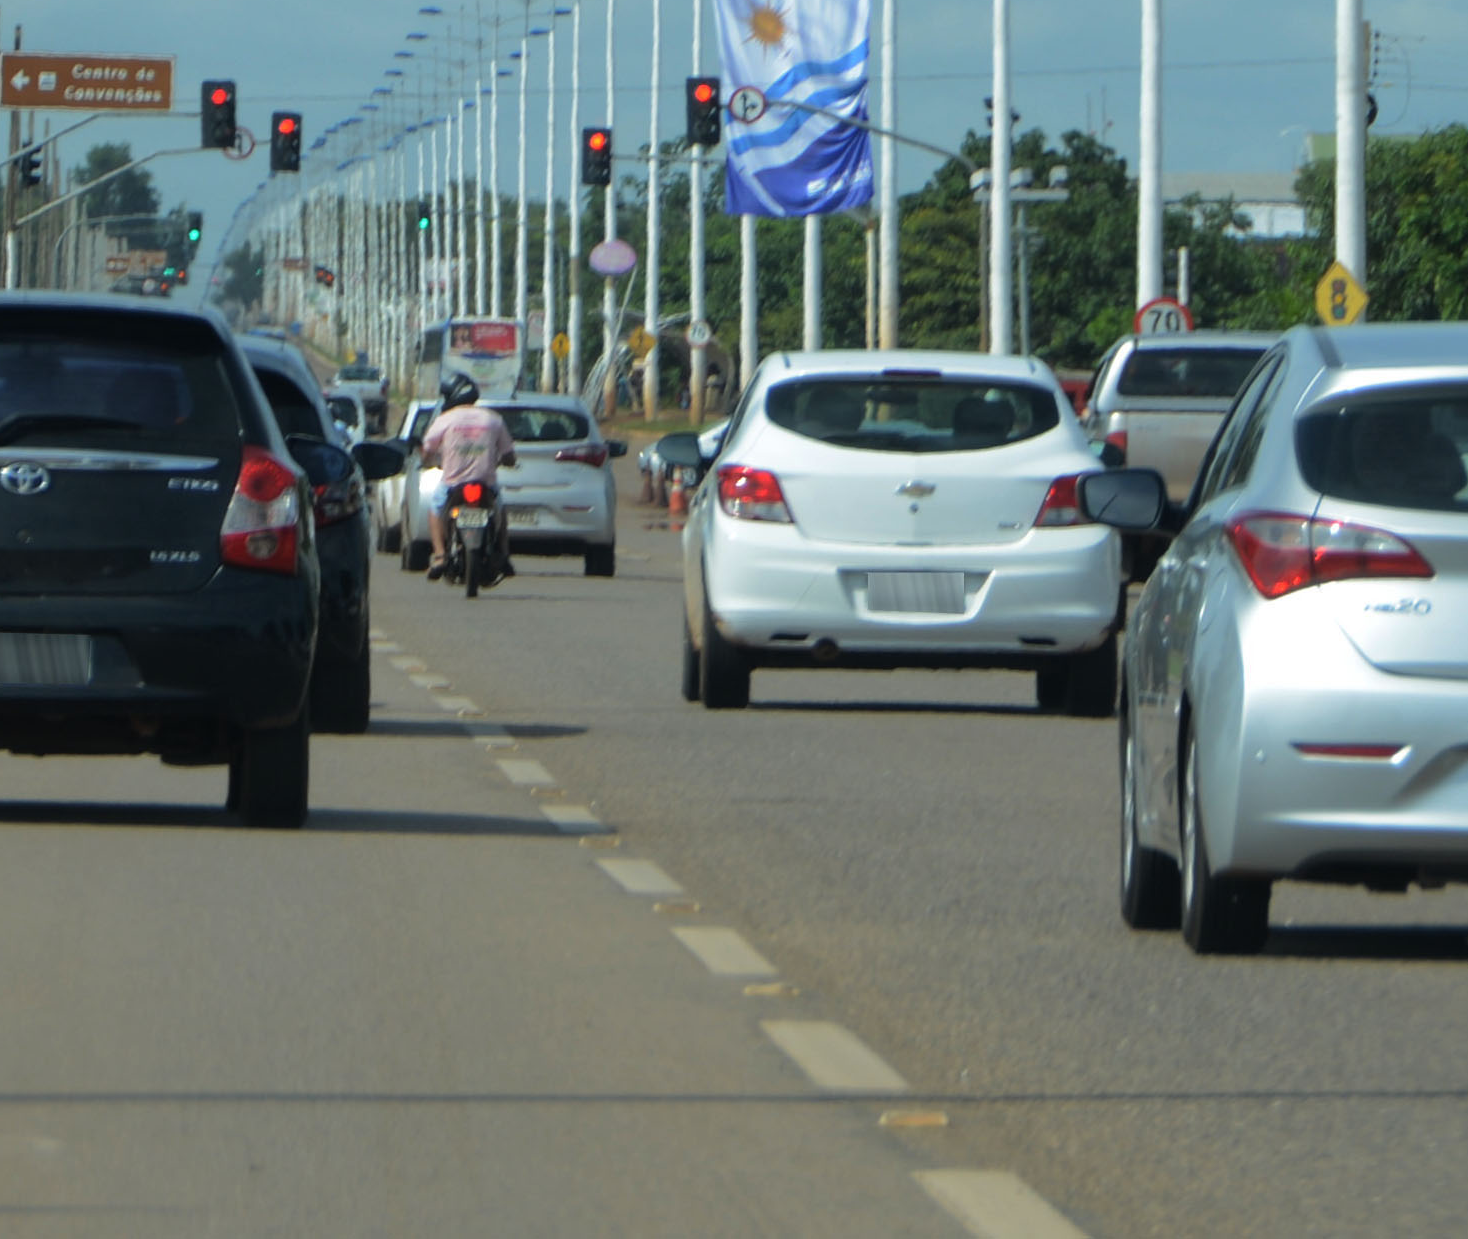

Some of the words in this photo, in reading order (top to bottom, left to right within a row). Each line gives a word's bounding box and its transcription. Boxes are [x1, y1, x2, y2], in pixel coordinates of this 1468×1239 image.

[71, 63, 129, 81] Centro
[135, 66, 156, 82] de
[63, 85, 163, 104] Convenções
[1148, 309, 1181, 333] 70
